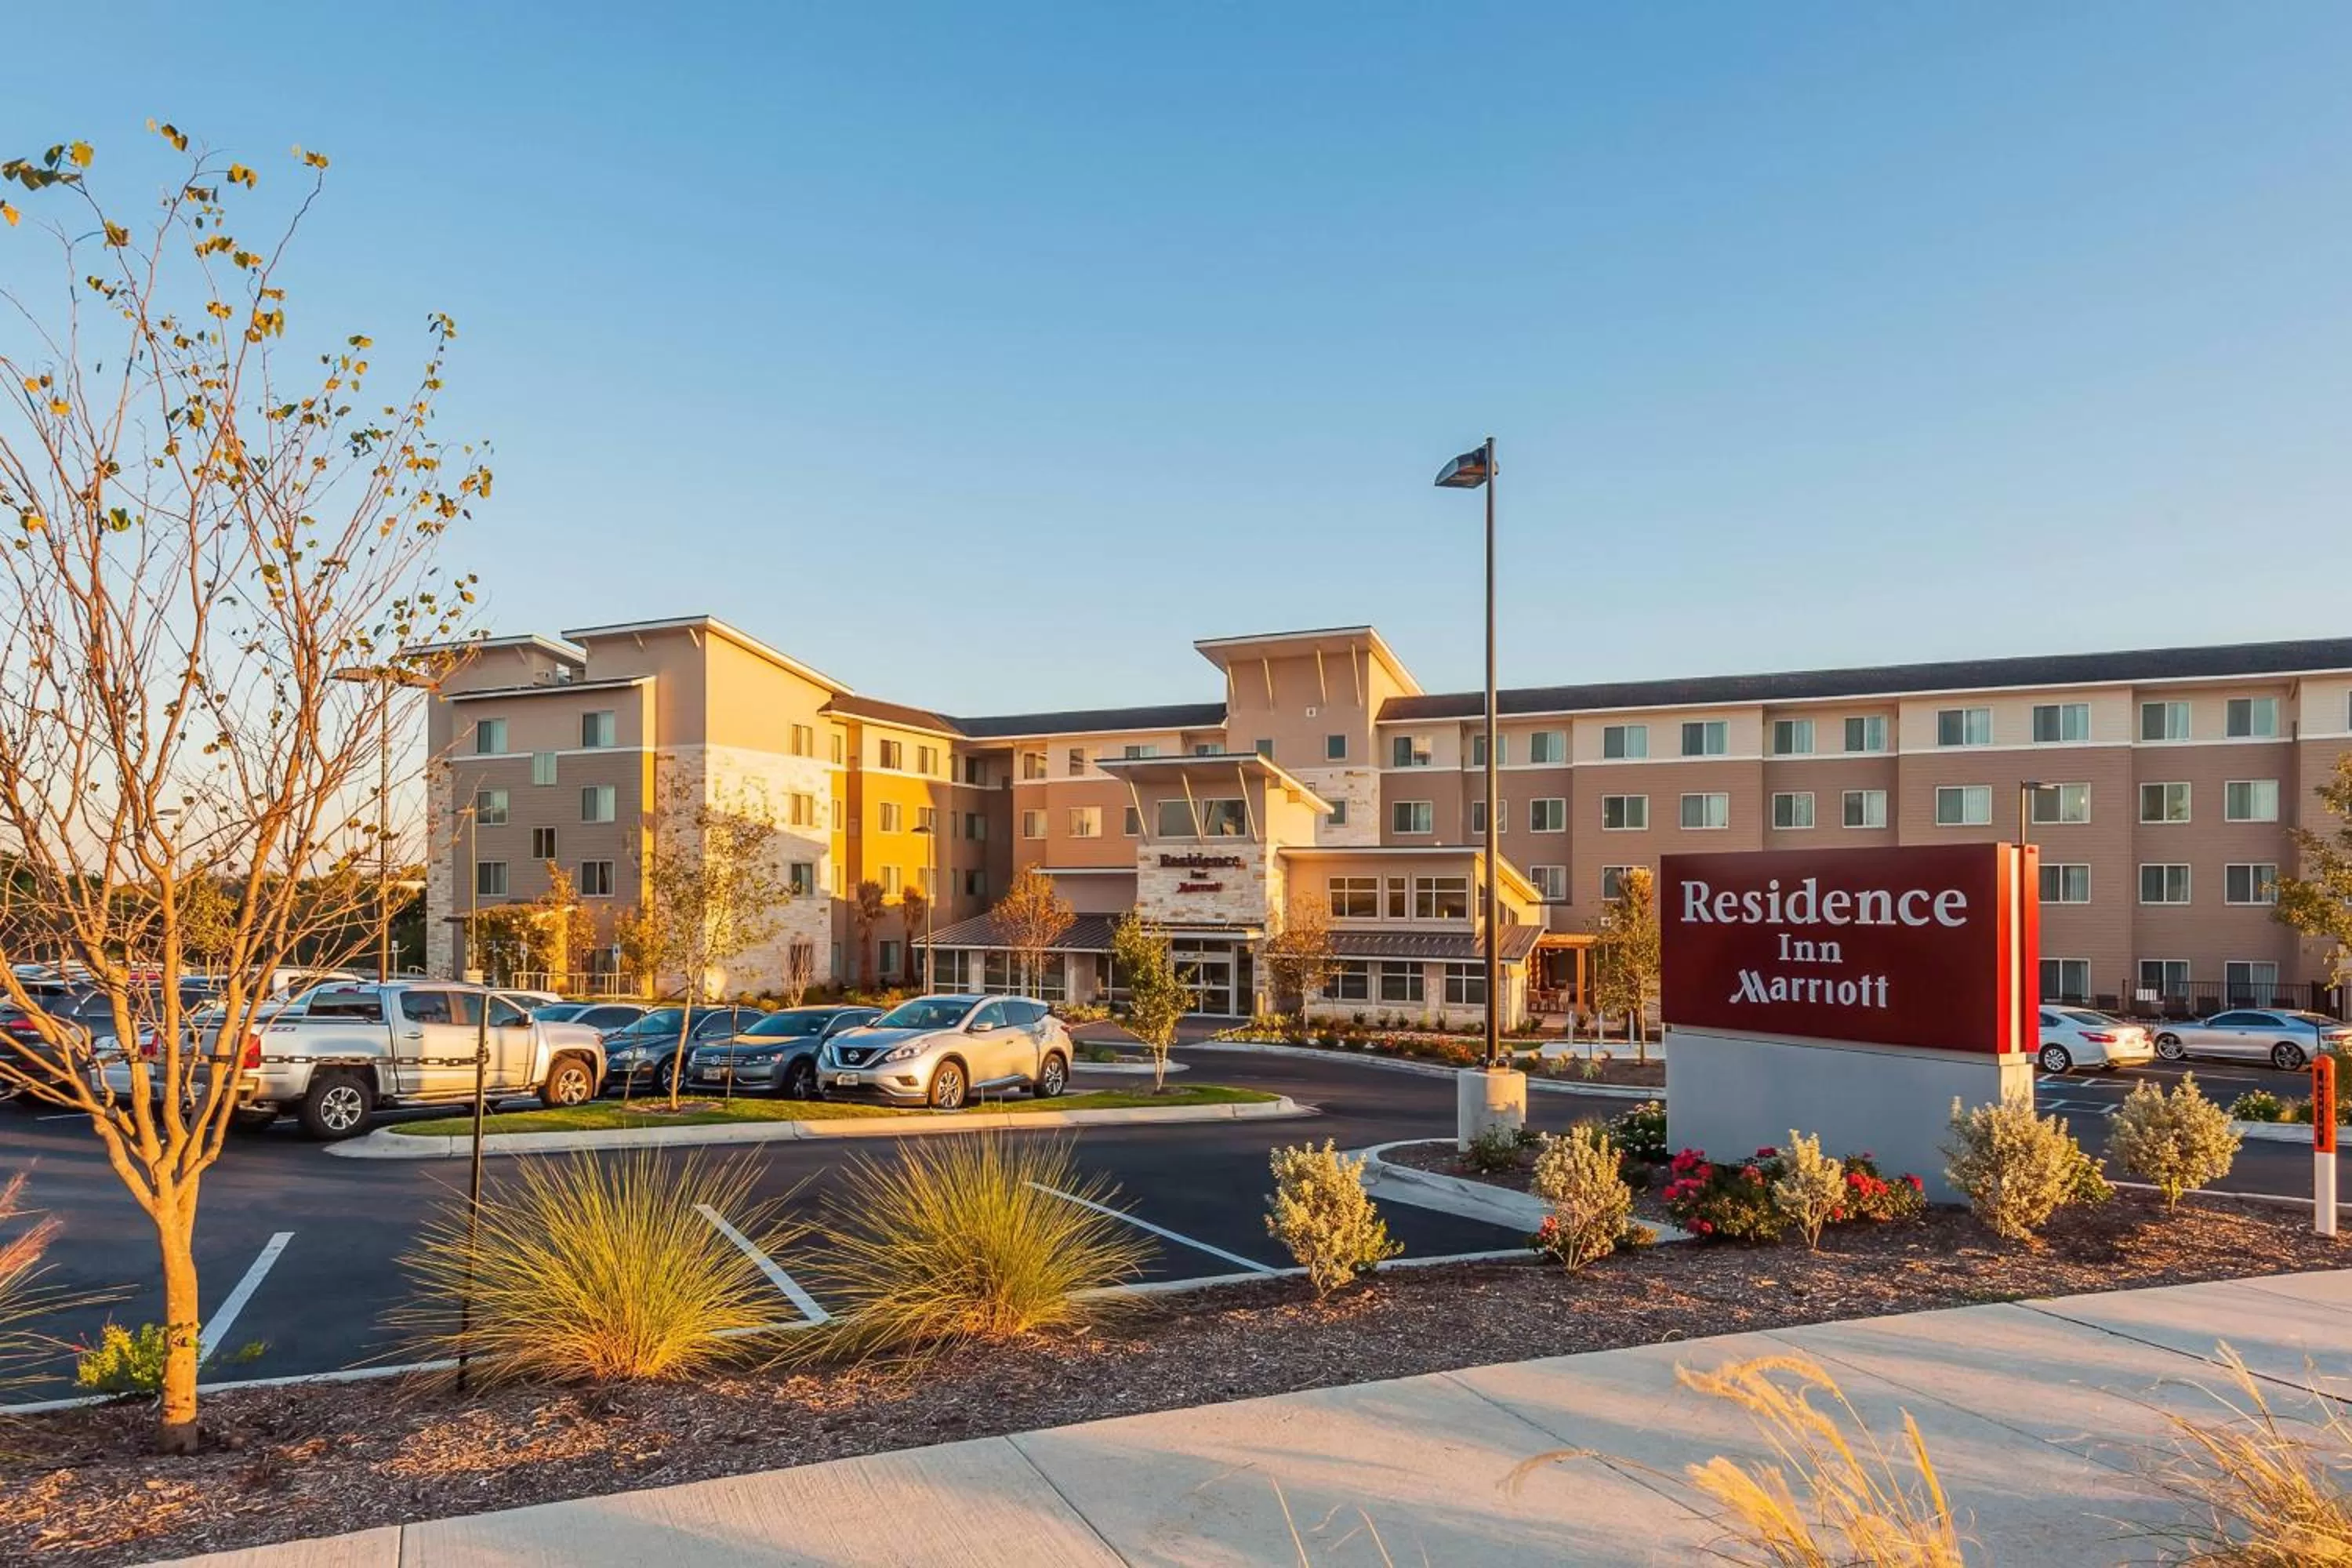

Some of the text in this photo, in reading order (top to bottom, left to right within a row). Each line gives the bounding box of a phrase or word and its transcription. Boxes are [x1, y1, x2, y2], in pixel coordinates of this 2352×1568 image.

[1680, 877, 1967, 927] Residence
[1777, 933, 1843, 964] Inn
[1729, 968, 1889, 1008] Marriott
